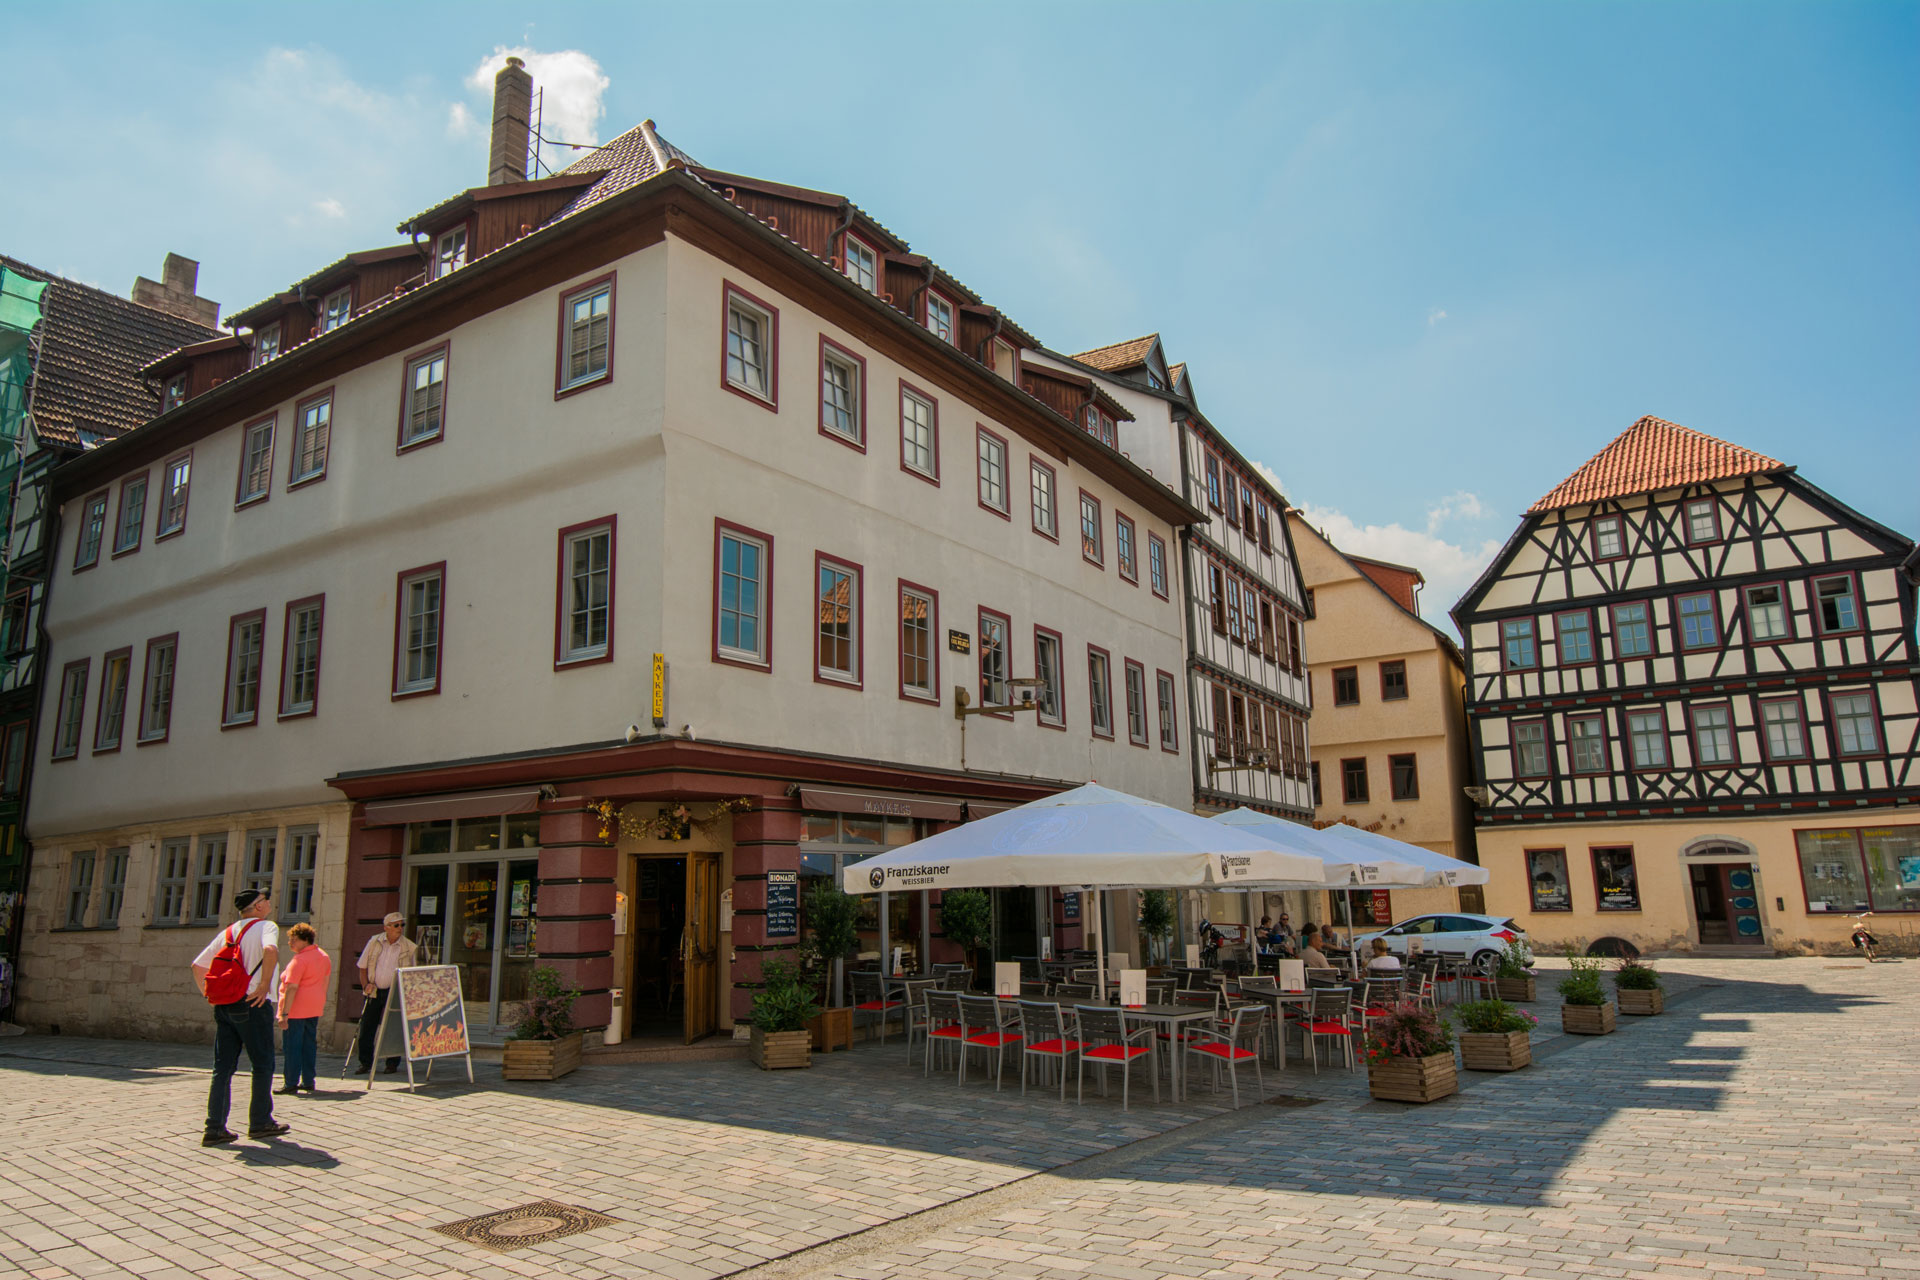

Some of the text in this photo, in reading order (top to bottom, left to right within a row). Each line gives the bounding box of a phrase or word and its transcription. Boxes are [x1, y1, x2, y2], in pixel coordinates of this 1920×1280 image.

[887, 865, 950, 877] Franziskaner
[770, 874, 795, 882] BIONADE
[902, 877, 935, 885] WEISSBIER
